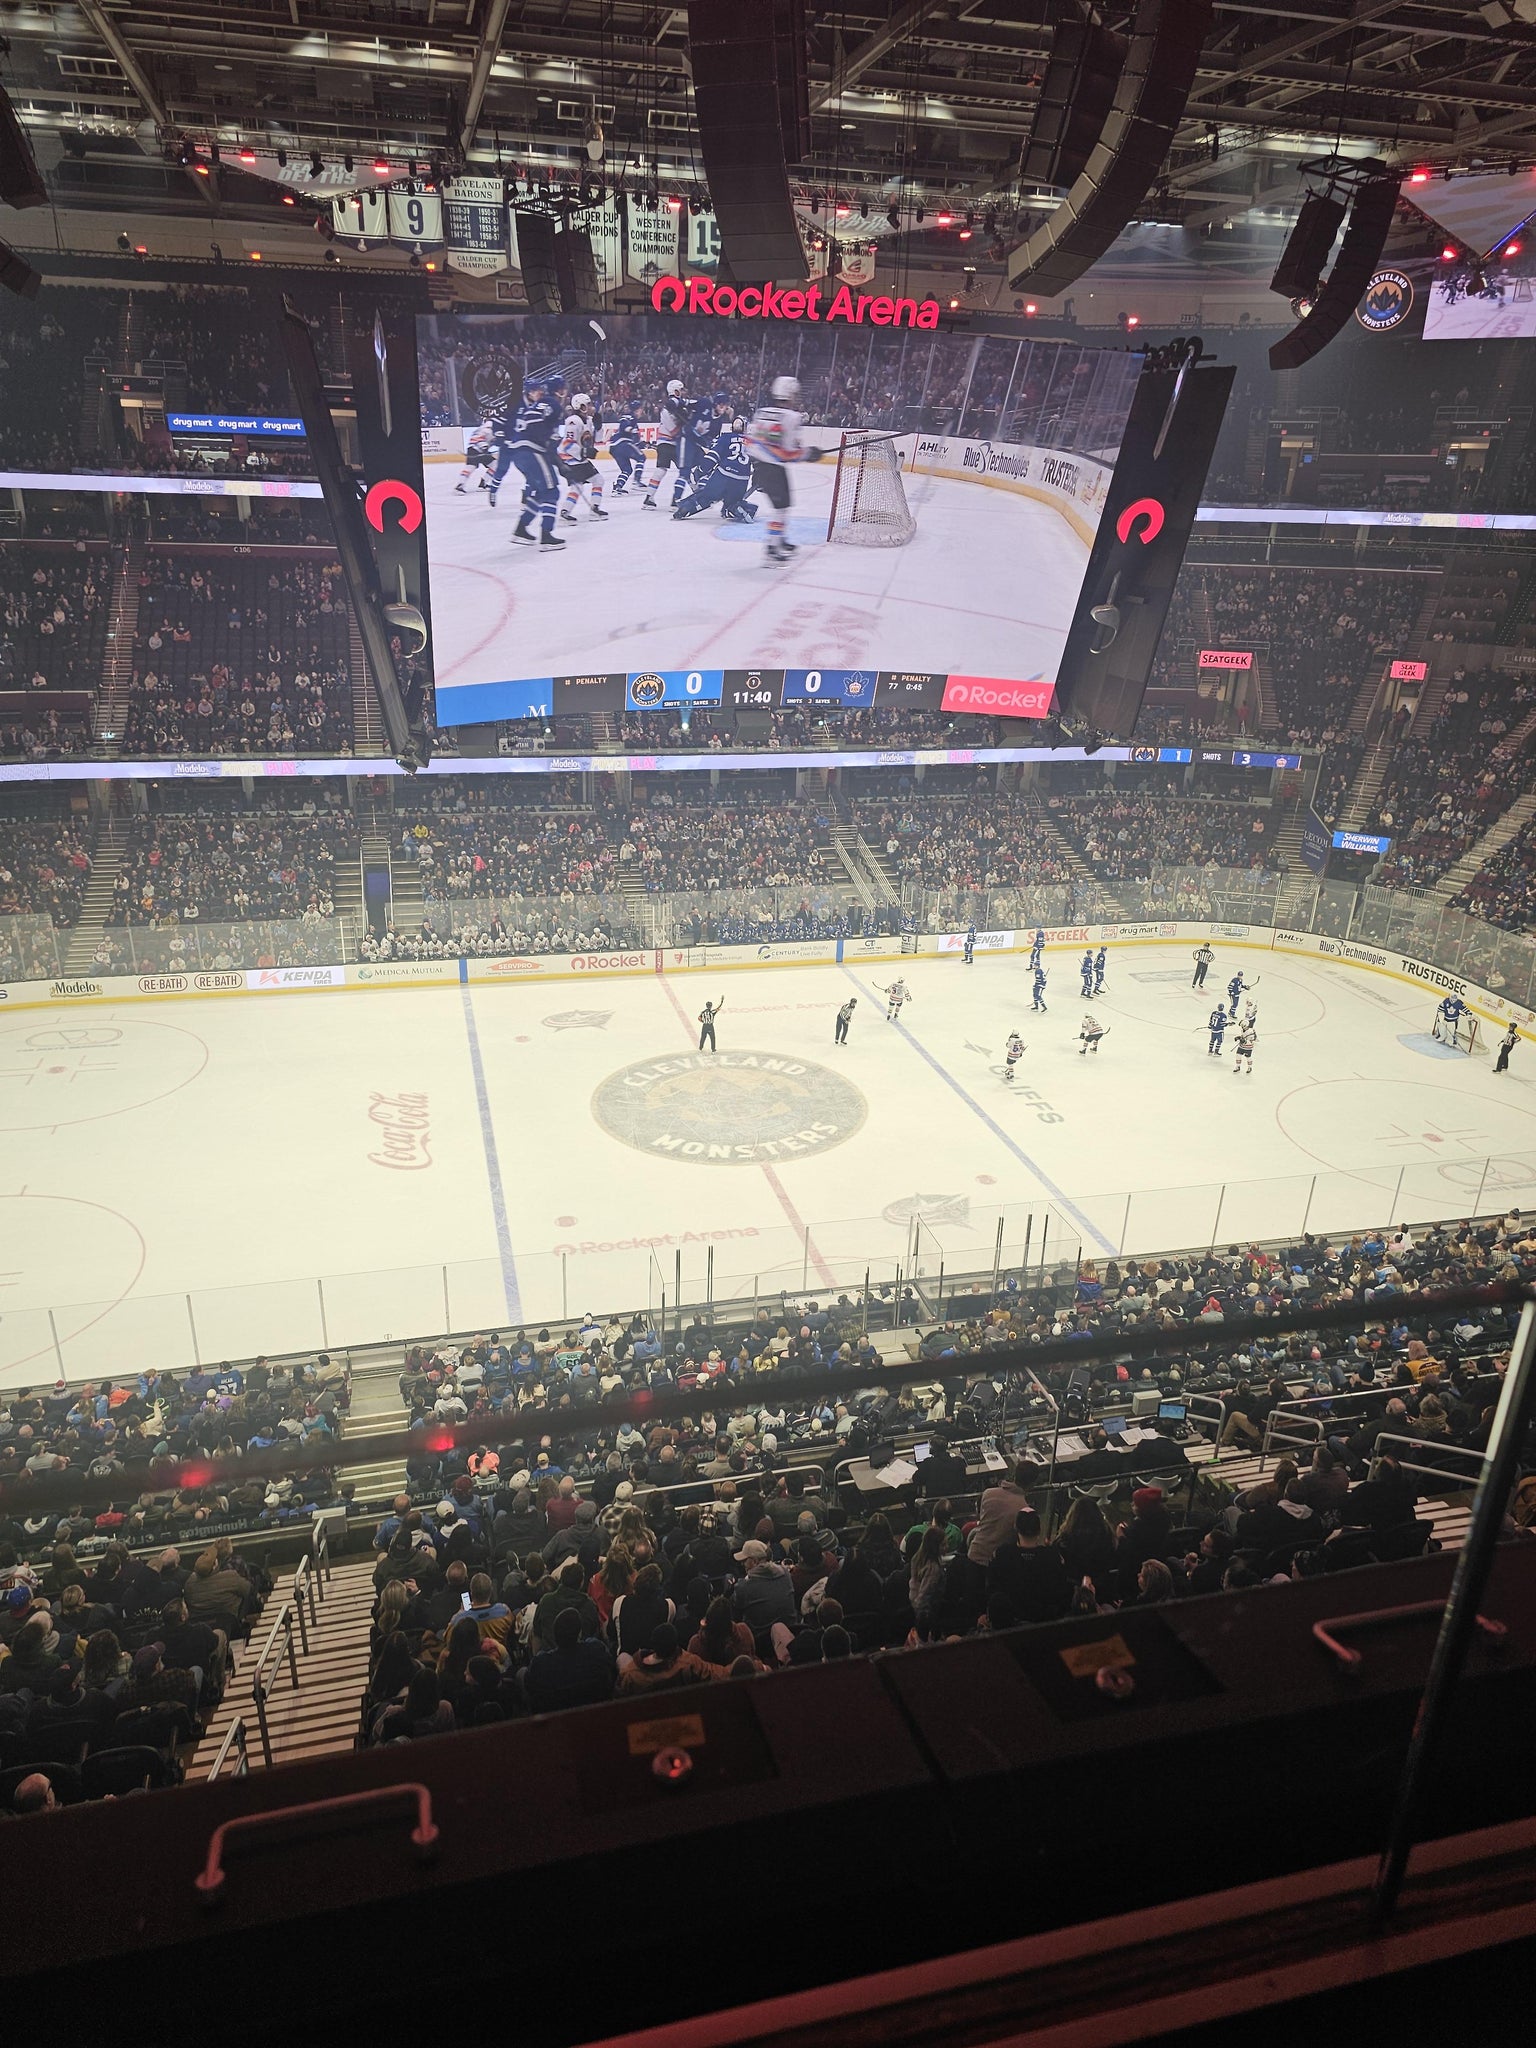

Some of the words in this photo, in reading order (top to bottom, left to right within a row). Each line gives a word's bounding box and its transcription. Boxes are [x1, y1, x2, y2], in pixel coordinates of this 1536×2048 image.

[450, 180, 501, 190] LEVELAND
[454, 189, 493, 199] BARONS
[407, 199, 424, 236] 9
[571, 211, 601, 223] CALDER
[603, 212, 619, 223] CUP
[636, 218, 671, 229] WESTERN
[630, 232, 677, 243] CONFERENCE
[632, 243, 675, 255] CHAMPIONS
[1366, 273, 1408, 290] CLEVELAND
[689, 276, 821, 320] Rocket
[826, 286, 940, 329] Arena
[1361, 313, 1401, 328] MONSTERS
[173, 417, 193, 428] drug
[193, 419, 213, 427] mart
[218, 418, 237, 429] drug
[238, 420, 258, 428] mart
[262, 421, 281, 431] drug
[282, 422, 302, 431] mart
[963, 446, 979, 468] Blue
[986, 450, 1031, 480] Technologies
[184, 481, 212, 490] Modelo
[1386, 513, 1411, 524] Modelo
[1202, 654, 1248, 665] SEATGEEK
[1398, 669, 1416, 677] GEEK
[575, 677, 607, 685] PENALTY
[686, 672, 703, 695] 0
[805, 671, 822, 693] 0
[905, 683, 923, 691] 0:45
[733, 691, 772, 704] 11:40
[969, 685, 1047, 709] Rocket
[551, 758, 580, 768] Modelo
[880, 753, 903, 763] Modelo
[1202, 753, 1222, 761] SHOTS
[1241, 754, 1251, 765] 3
[176, 763, 207, 773] Modelo
[267, 762, 295, 775] PLAY
[1342, 832, 1380, 845] SHERWIN
[1026, 927, 1090, 944] SATGEEK
[1119, 927, 1138, 936] drug
[1139, 925, 1158, 934] mart
[1319, 940, 1335, 953] Blue
[1342, 946, 1387, 966] Technologies
[498, 962, 533, 971] SERVPRO
[588, 953, 646, 970] Rocket
[283, 970, 332, 982] KENDA
[374, 967, 410, 977] MEDICAL
[412, 966, 444, 975] MUTUAL
[1401, 959, 1468, 997] TRUSTEDSEC
[54, 981, 96, 995] Modelo
[622, 1055, 808, 1087] CLEVELAND
[650, 1120, 839, 1159] MONSTERS
[580, 1233, 676, 1255] Rocket
[682, 1226, 760, 1244] Arena
